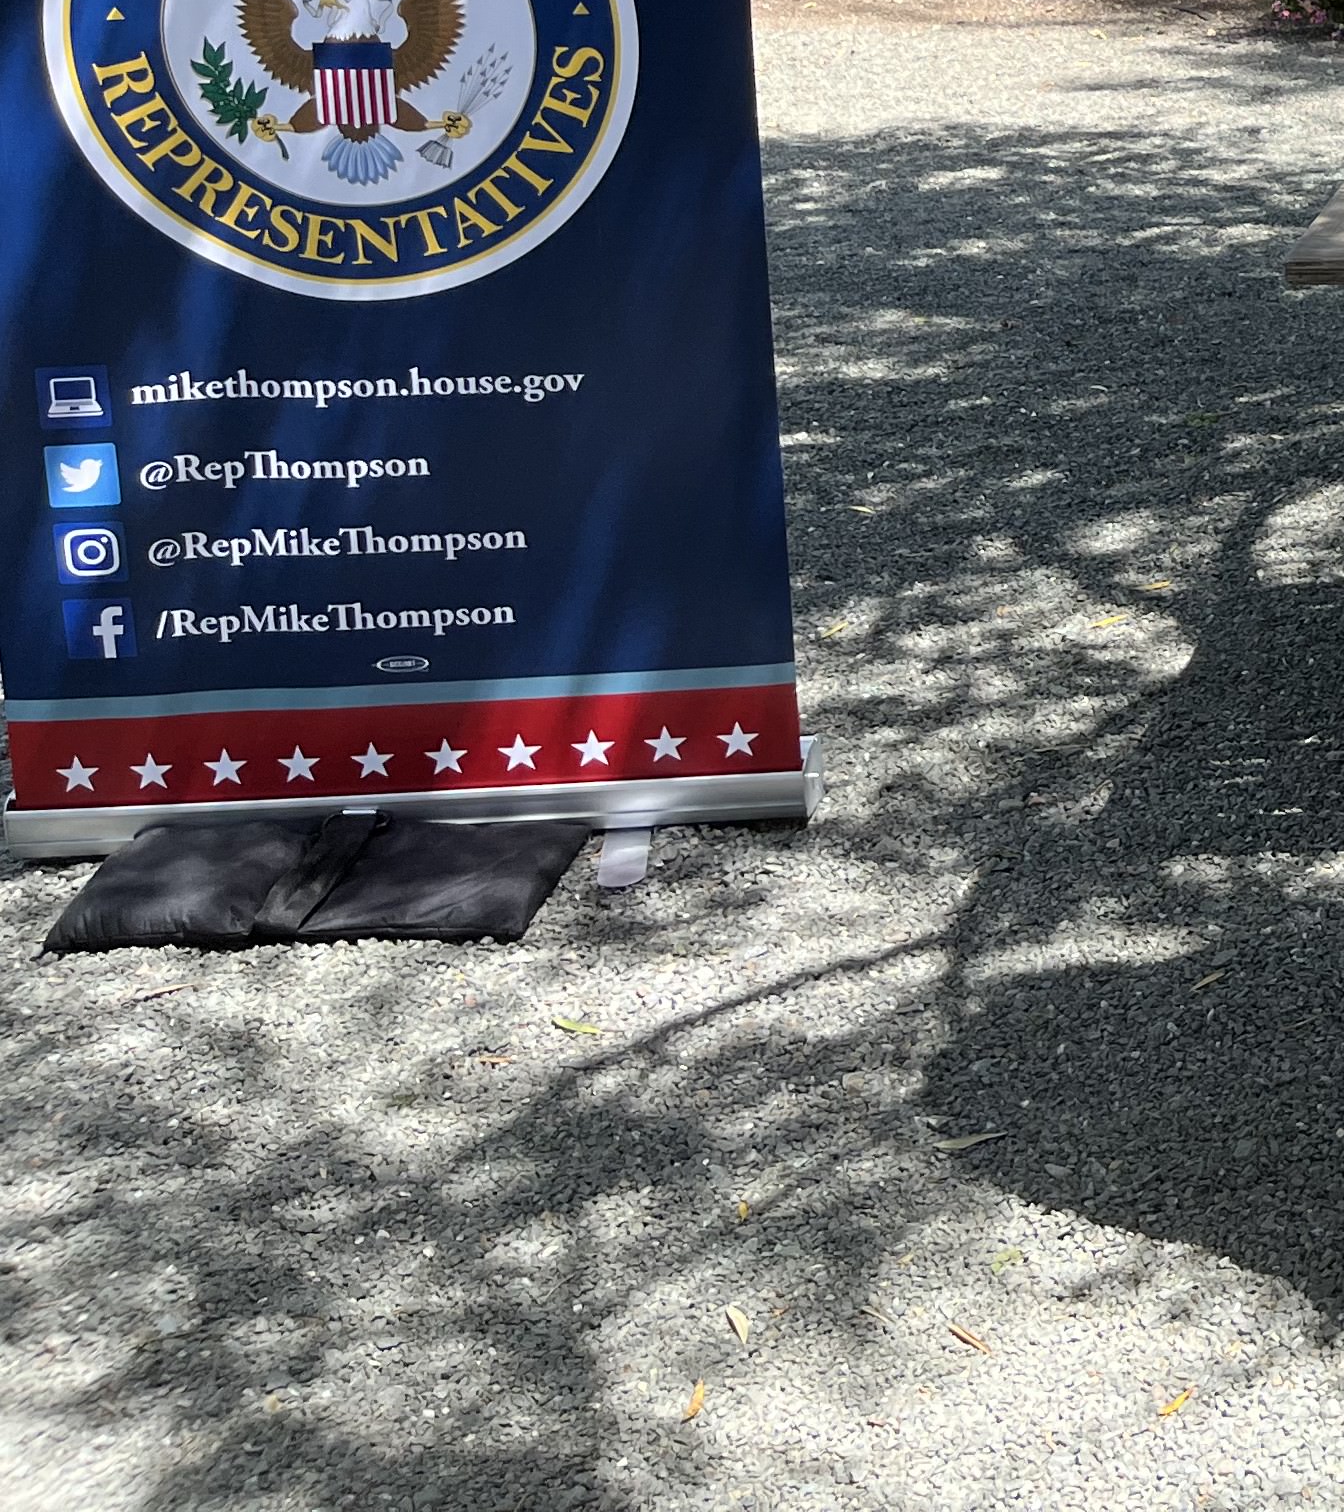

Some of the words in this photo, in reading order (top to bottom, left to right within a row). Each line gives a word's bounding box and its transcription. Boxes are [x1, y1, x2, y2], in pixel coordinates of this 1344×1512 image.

[92, 44, 605, 265] REPRESENTATIVES
[130, 367, 586, 409] mikethompson.house.gov
[139, 449, 431, 489] @RepThompson
[148, 525, 528, 568] @RepMikeThompson
[156, 601, 517, 645] /RepMikeThompson
